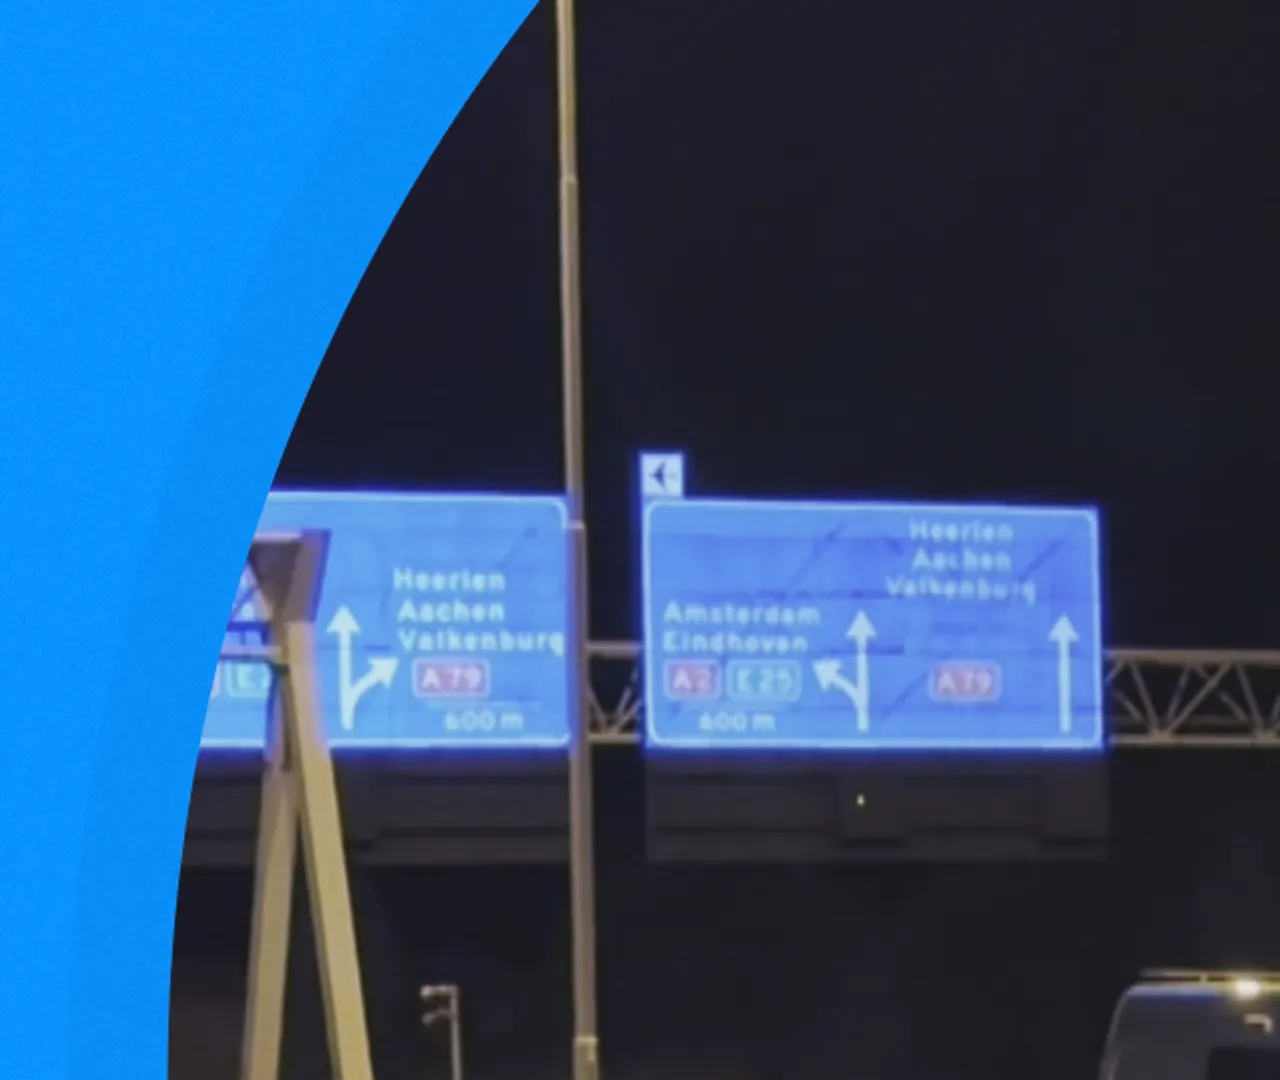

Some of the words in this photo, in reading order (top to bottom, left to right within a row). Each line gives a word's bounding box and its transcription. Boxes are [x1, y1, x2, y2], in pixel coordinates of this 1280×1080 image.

[908, 519, 1014, 541] Heerlen
[912, 547, 1012, 571] Aachen
[393, 567, 506, 591] Heerlen
[885, 575, 1036, 608] Valkenburg
[398, 599, 505, 623] Aachen
[663, 600, 821, 626] Amsterdam
[398, 629, 565, 658] Valkenburg
[662, 630, 808, 654] Eindhoven
